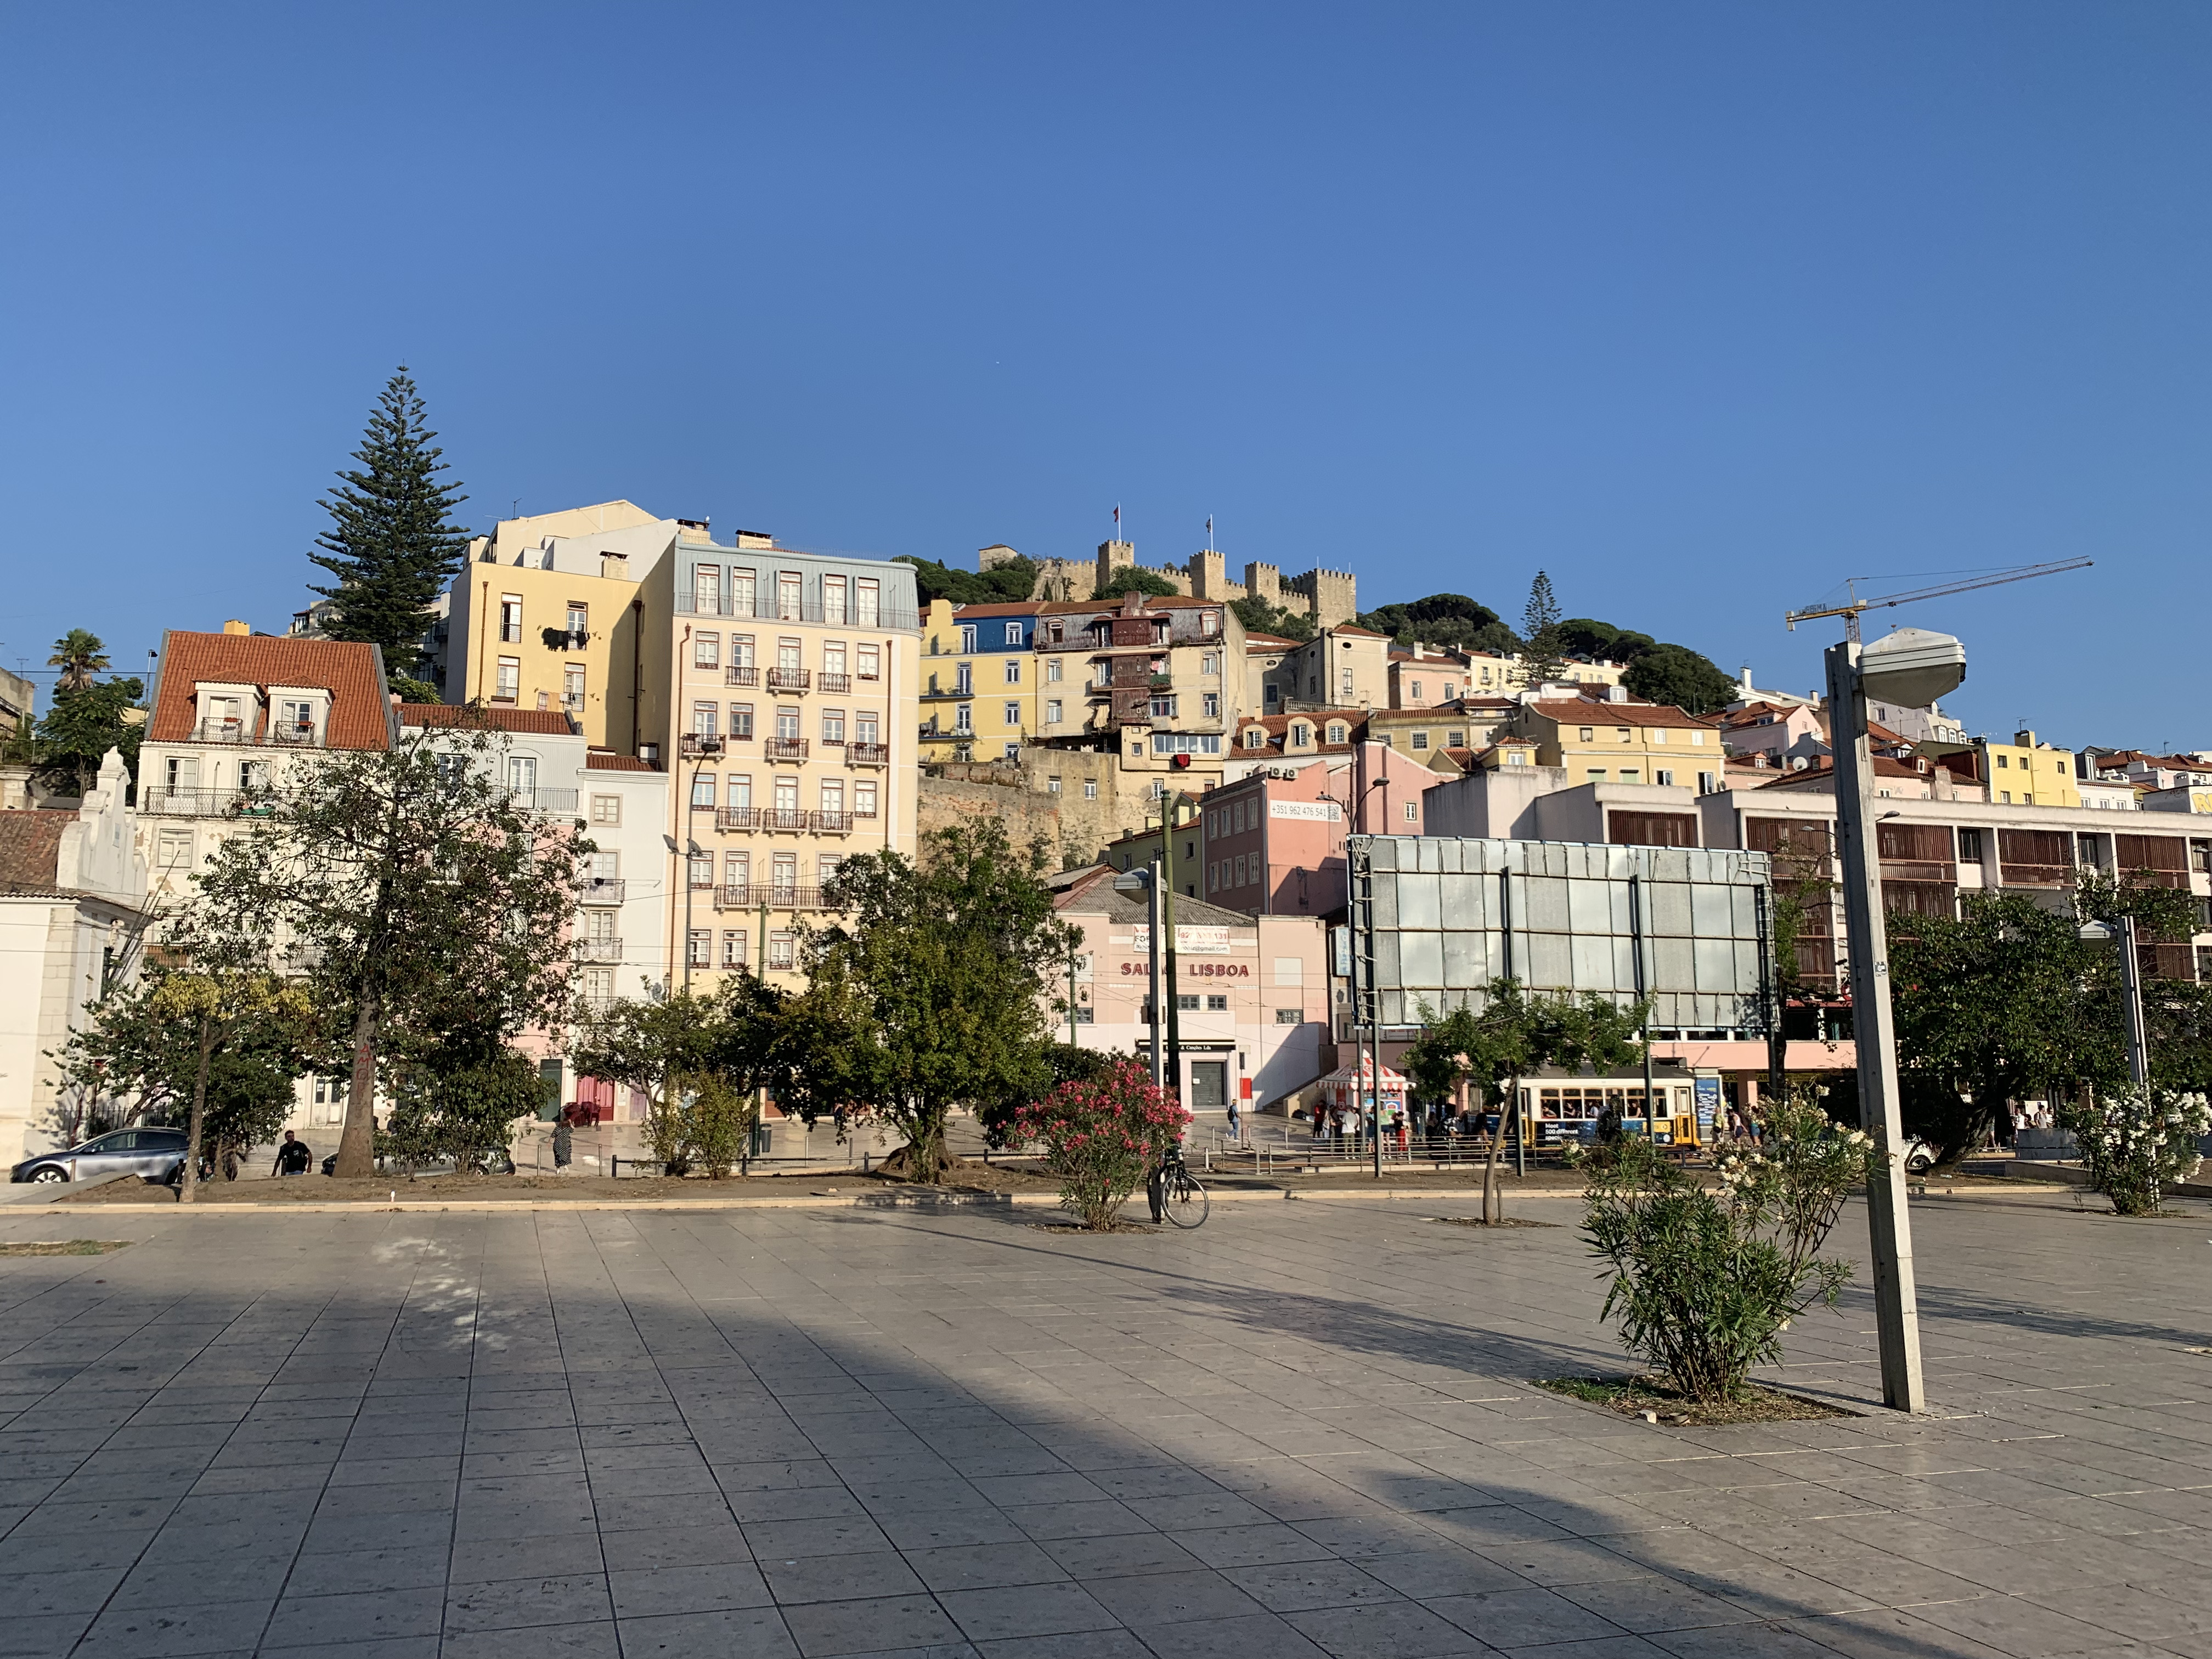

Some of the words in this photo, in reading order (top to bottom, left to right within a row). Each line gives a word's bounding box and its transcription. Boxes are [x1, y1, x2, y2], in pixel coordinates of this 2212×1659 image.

[1272, 805, 1287, 814] +351
[1290, 806, 1301, 815] 962
[1303, 807, 1314, 816] 476
[1316, 808, 1327, 817] 541
[1190, 964, 1249, 977] LISBOA
